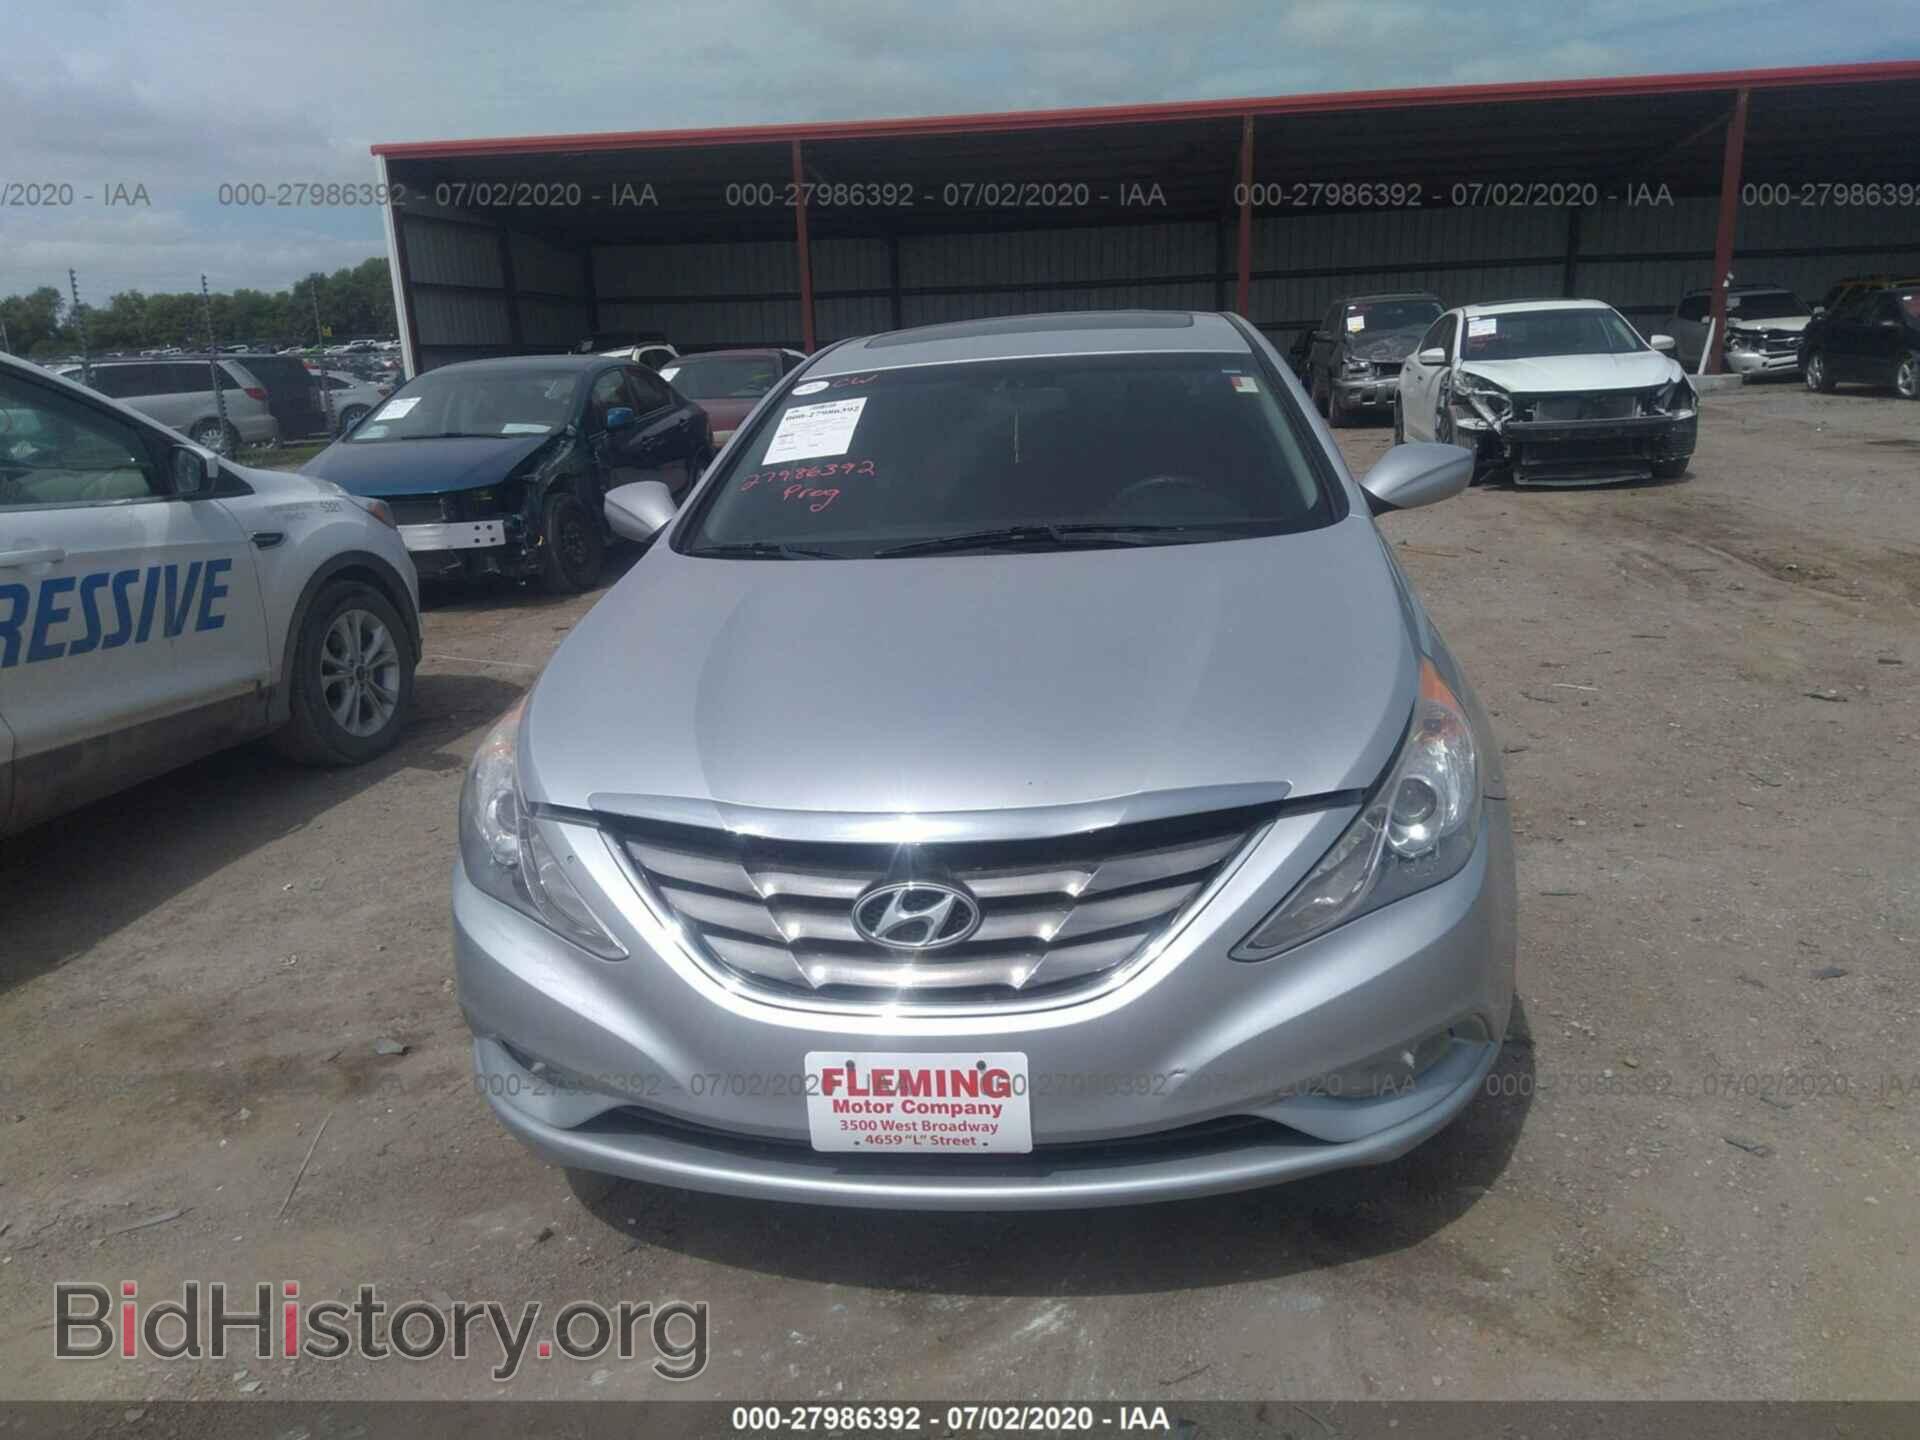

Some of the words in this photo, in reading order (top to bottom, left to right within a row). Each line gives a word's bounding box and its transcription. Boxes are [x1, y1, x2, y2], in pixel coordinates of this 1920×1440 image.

[0, 558, 233, 668] RESSIVE
[821, 1068, 1012, 1098] FLEMING
[832, 1099, 894, 1114] Motor
[901, 1099, 1003, 1118] Company
[840, 1119, 878, 1132] 3500
[880, 1120, 918, 1132] West
[922, 1120, 999, 1135] Broadway
[864, 1134, 902, 1145] 4659
[930, 1135, 977, 1146] Street
